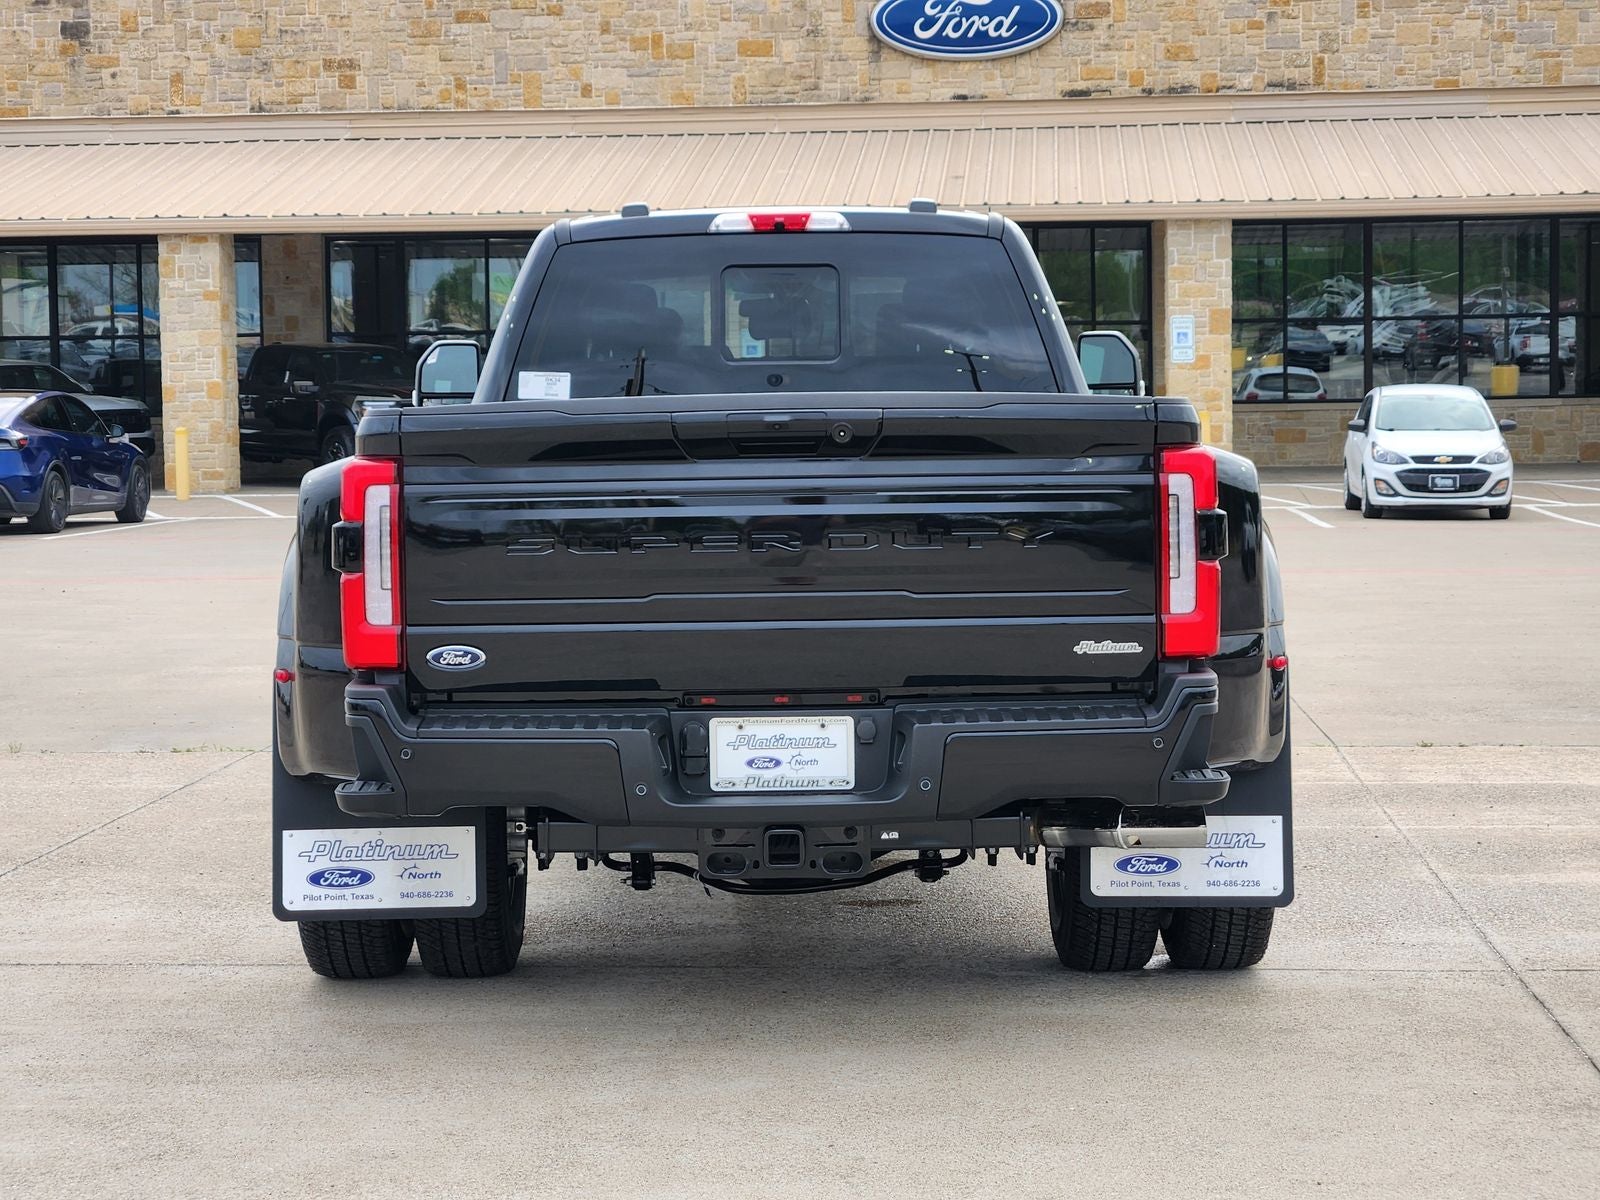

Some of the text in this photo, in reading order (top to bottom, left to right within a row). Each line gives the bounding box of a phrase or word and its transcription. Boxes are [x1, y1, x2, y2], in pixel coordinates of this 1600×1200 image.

[913, 0, 1020, 39] Ford
[506, 528, 1055, 556] SUPER DUTY
[1073, 640, 1143, 654] Platinum
[727, 733, 837, 750] Platinum
[794, 758, 819, 766] North
[744, 776, 826, 788] Platinum
[298, 839, 459, 862] Platinum
[1214, 859, 1248, 868] North
[407, 871, 442, 880] North
[1110, 880, 1129, 888] Pilot
[1132, 880, 1155, 888] Point,
[1158, 880, 1181, 888] Texas
[324, 893, 348, 901] Point,
[351, 892, 375, 900] Texas
[400, 890, 454, 899] 940-686-2236
